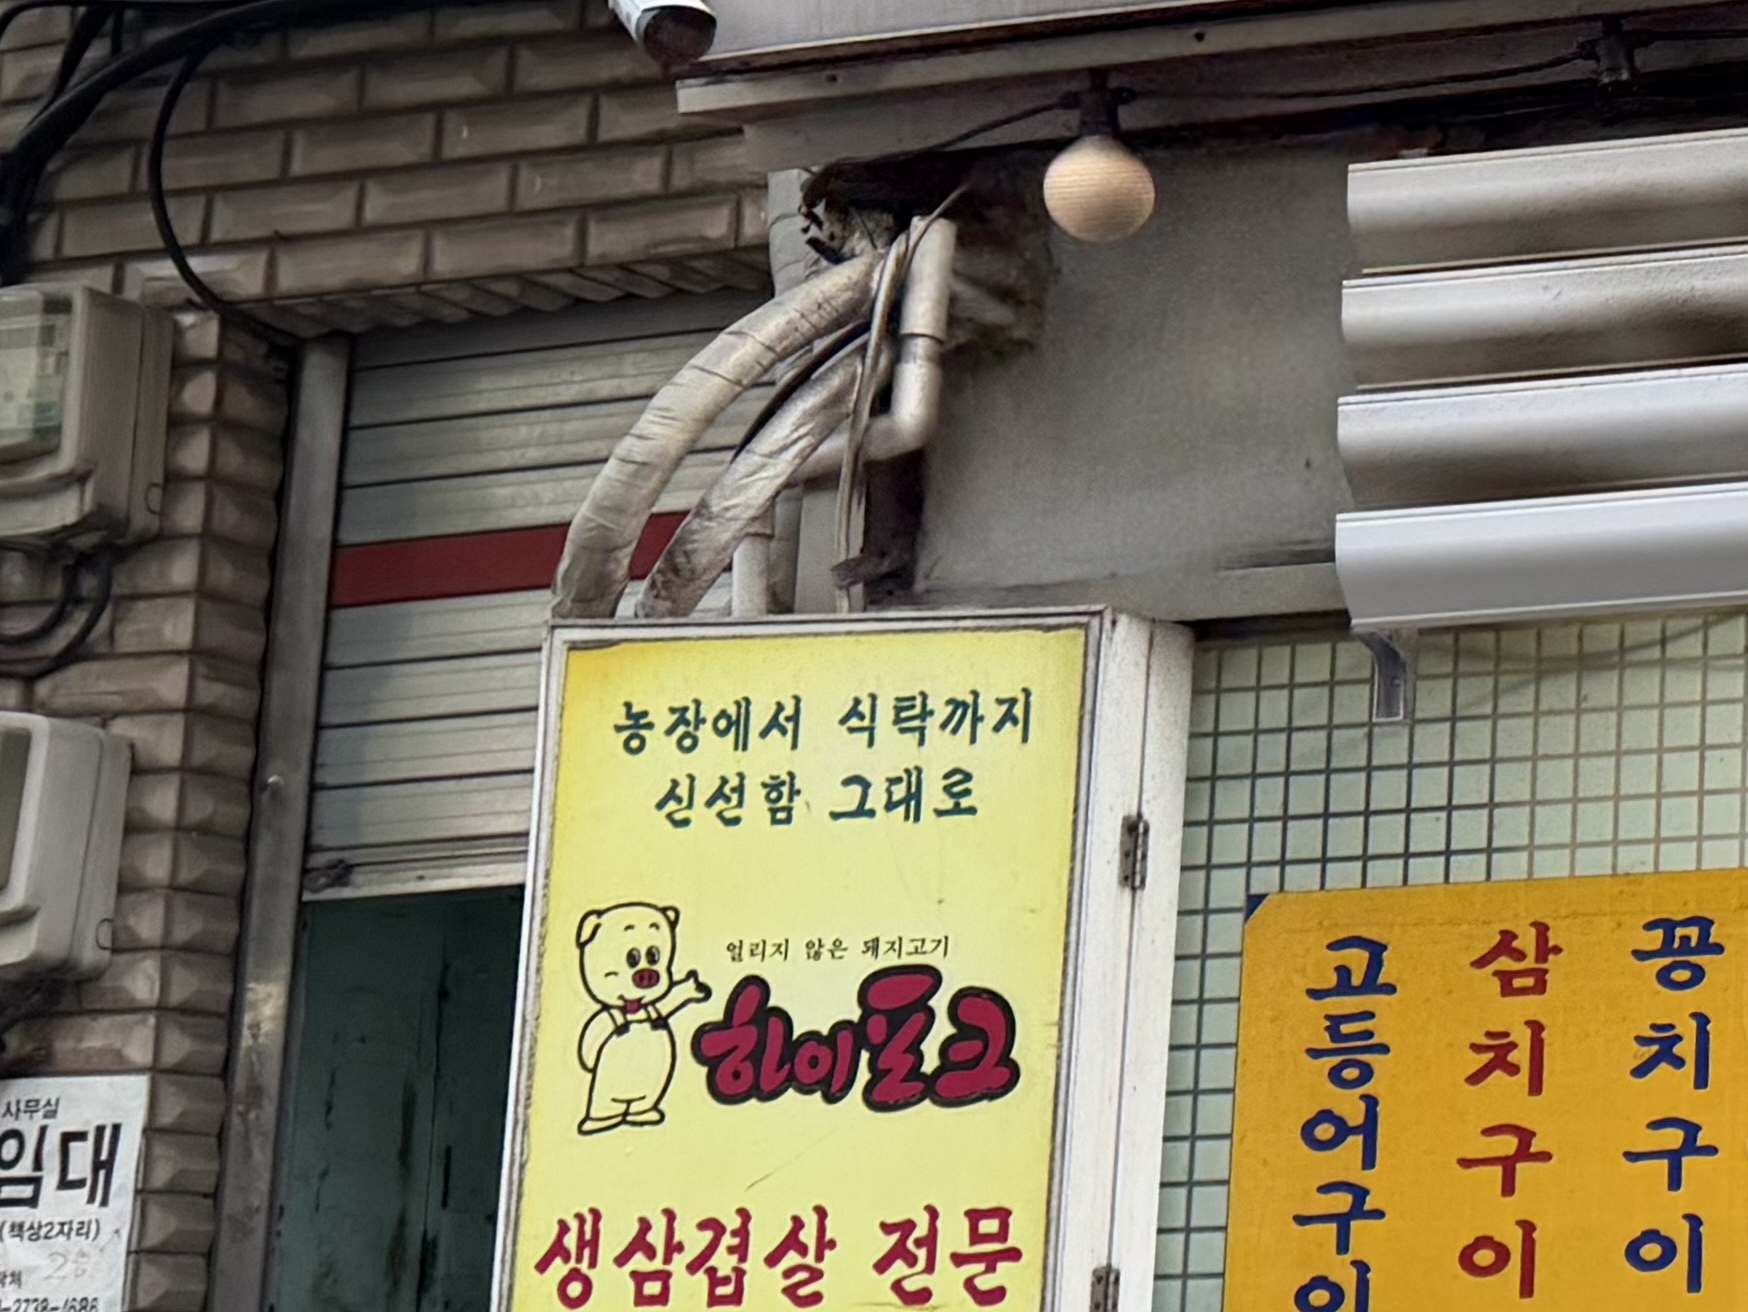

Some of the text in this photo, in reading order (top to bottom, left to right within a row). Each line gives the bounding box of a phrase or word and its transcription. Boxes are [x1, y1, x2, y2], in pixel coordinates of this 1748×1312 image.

[613, 687, 1033, 756] 농장에서 식탁까지
[655, 766, 979, 829] 신선함 그대로
[726, 935, 949, 962] 얼리지 않은 돼지고기
[692, 964, 1020, 1111] 하이포크
[0, 1123, 122, 1209] 임대
[534, 1204, 1023, 1309] 생삼겹살 전문
